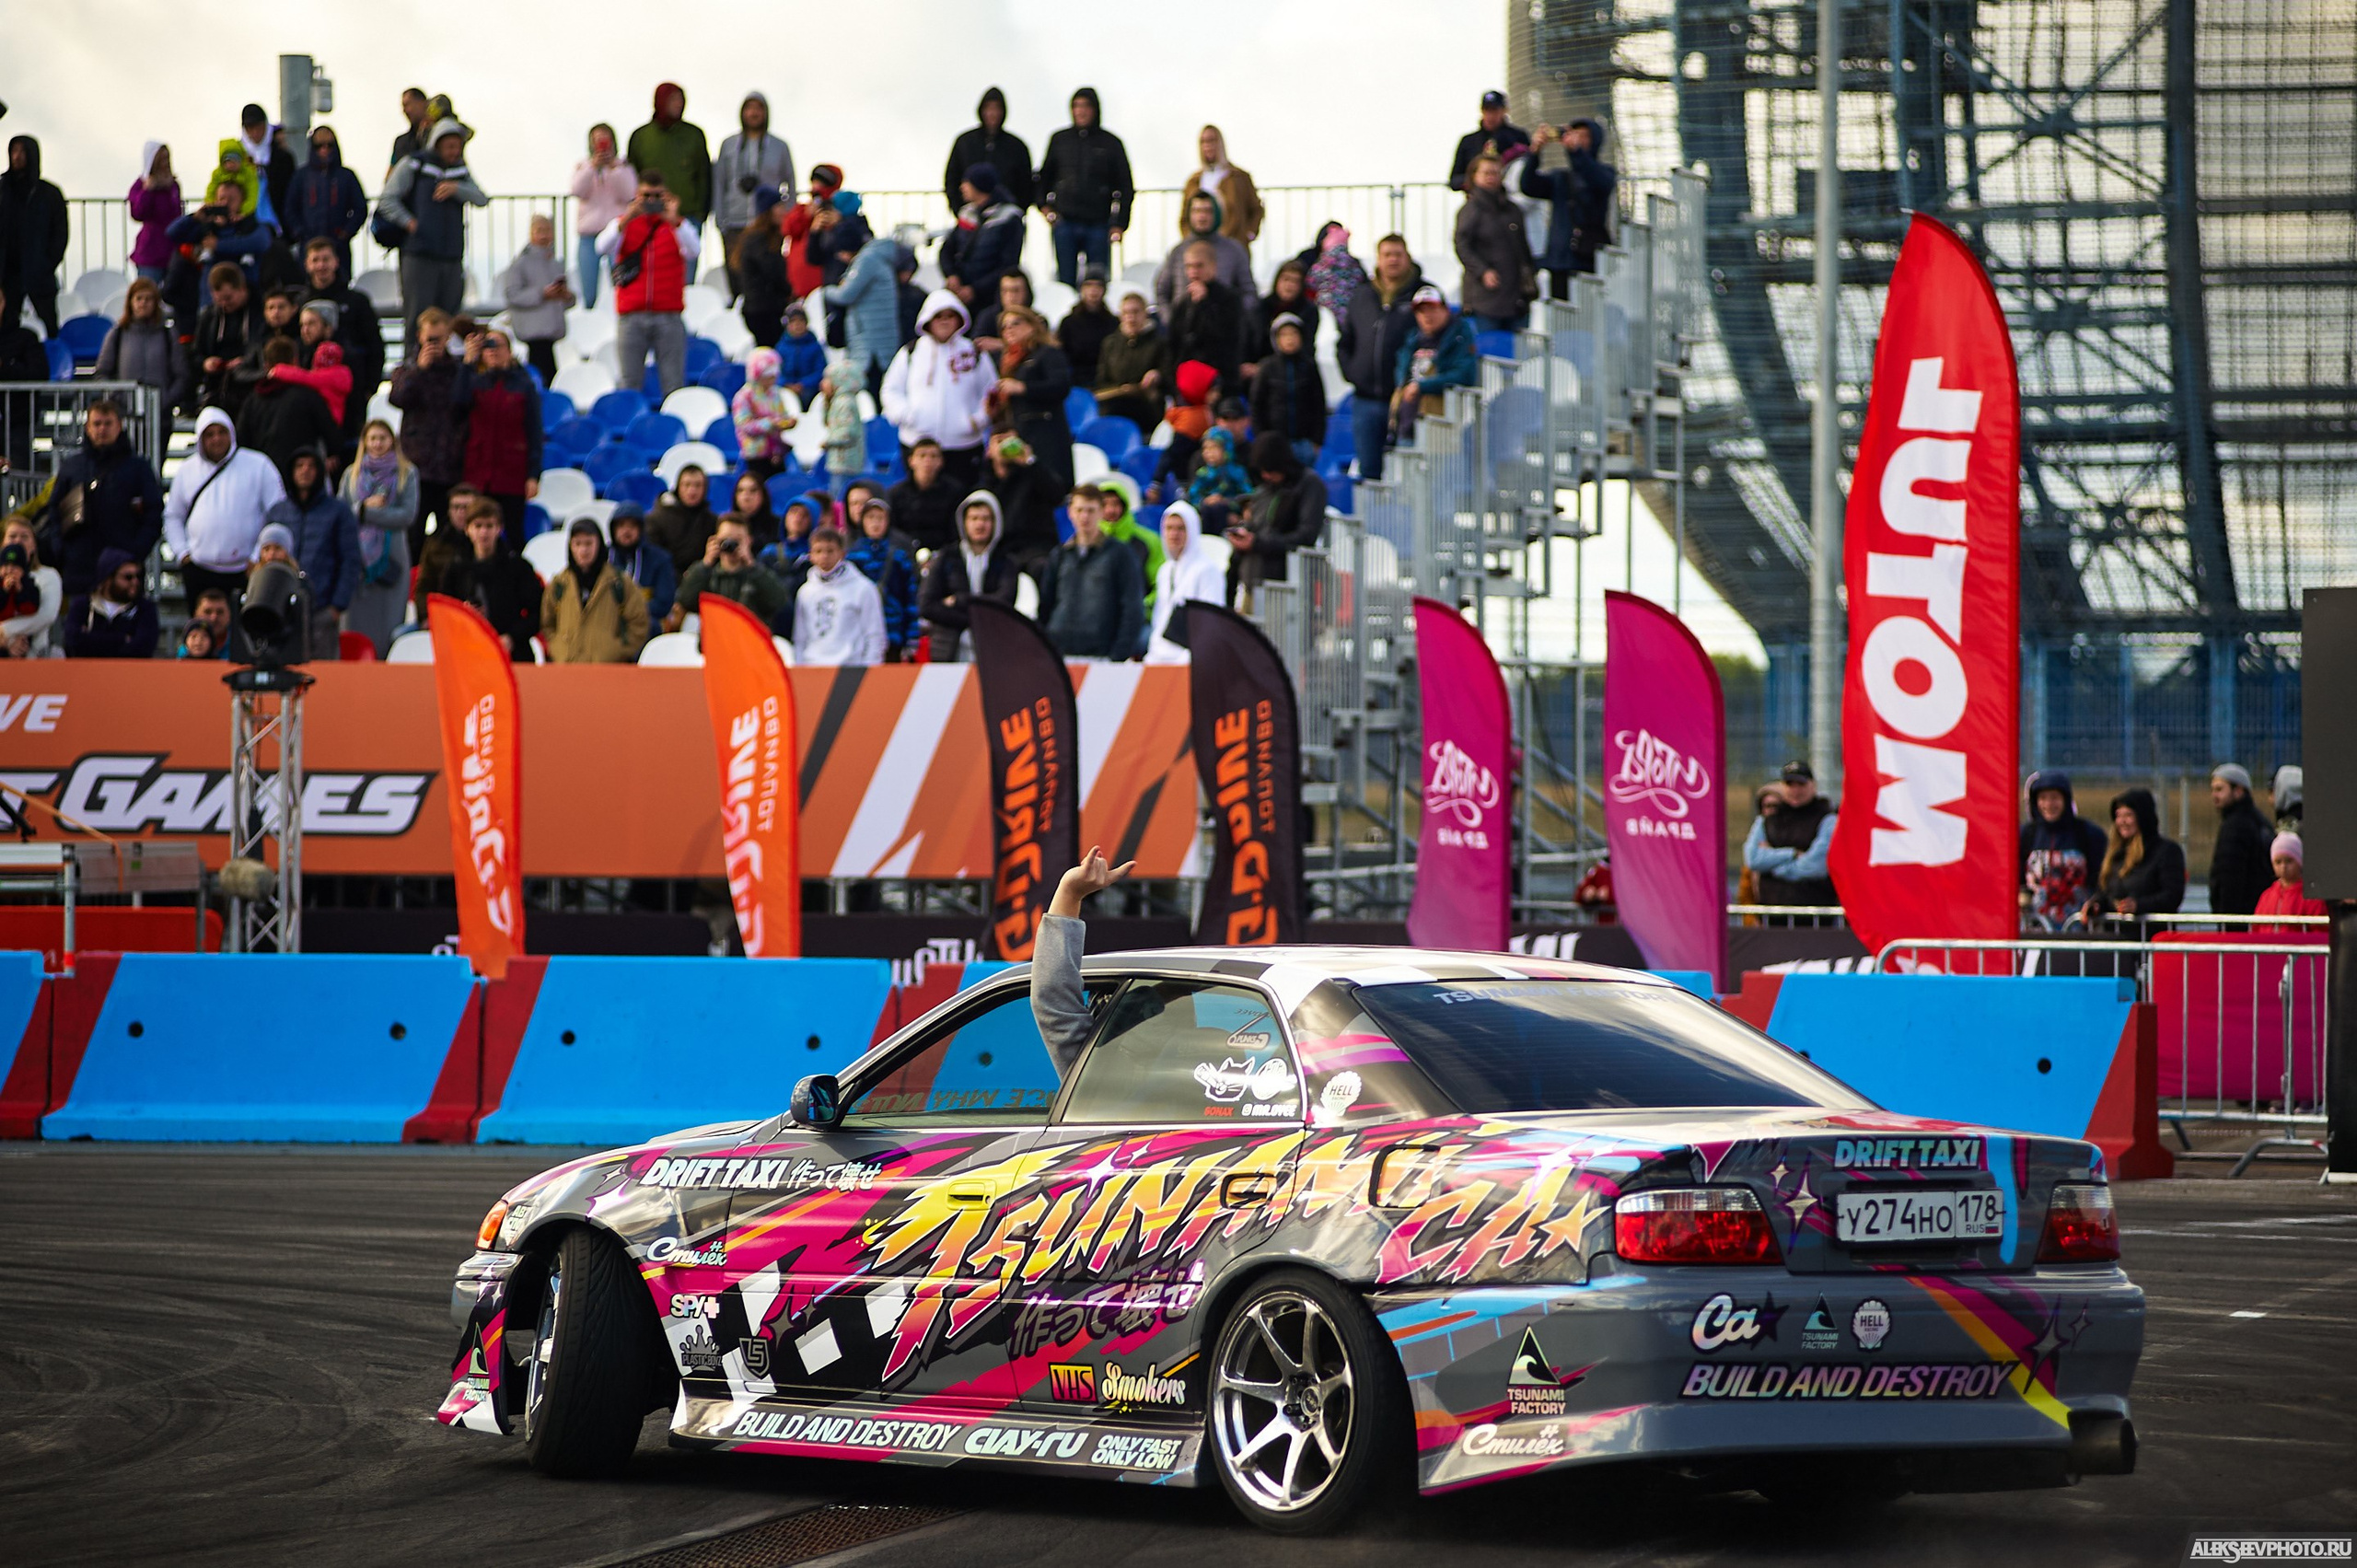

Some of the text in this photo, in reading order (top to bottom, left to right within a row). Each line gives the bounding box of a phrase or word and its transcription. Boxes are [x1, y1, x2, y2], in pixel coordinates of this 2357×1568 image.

[1329, 1085, 1353, 1097] HELL
[1834, 1139, 1980, 1167] DRIFT TAXI
[639, 1159, 790, 1190] DRIFT TAXI
[1958, 1194, 1996, 1222] 178
[1965, 1224, 1985, 1234] RUS
[1860, 1315, 1884, 1327] HELL
[1801, 1332, 1840, 1341] TSUNAMI
[1801, 1342, 1838, 1350] FACTORY
[1051, 1361, 1187, 1405] VHS Smokers
[1682, 1364, 2014, 1398] BUILD AND DESTROY
[1507, 1388, 1565, 1401] TSUNAMI
[1511, 1401, 1566, 1414] FACTORY
[732, 1411, 962, 1450] BUILD AND DESTROY
[1097, 1434, 1182, 1455] ONLY FAST
[1090, 1449, 1177, 1469] ONLY LOW
